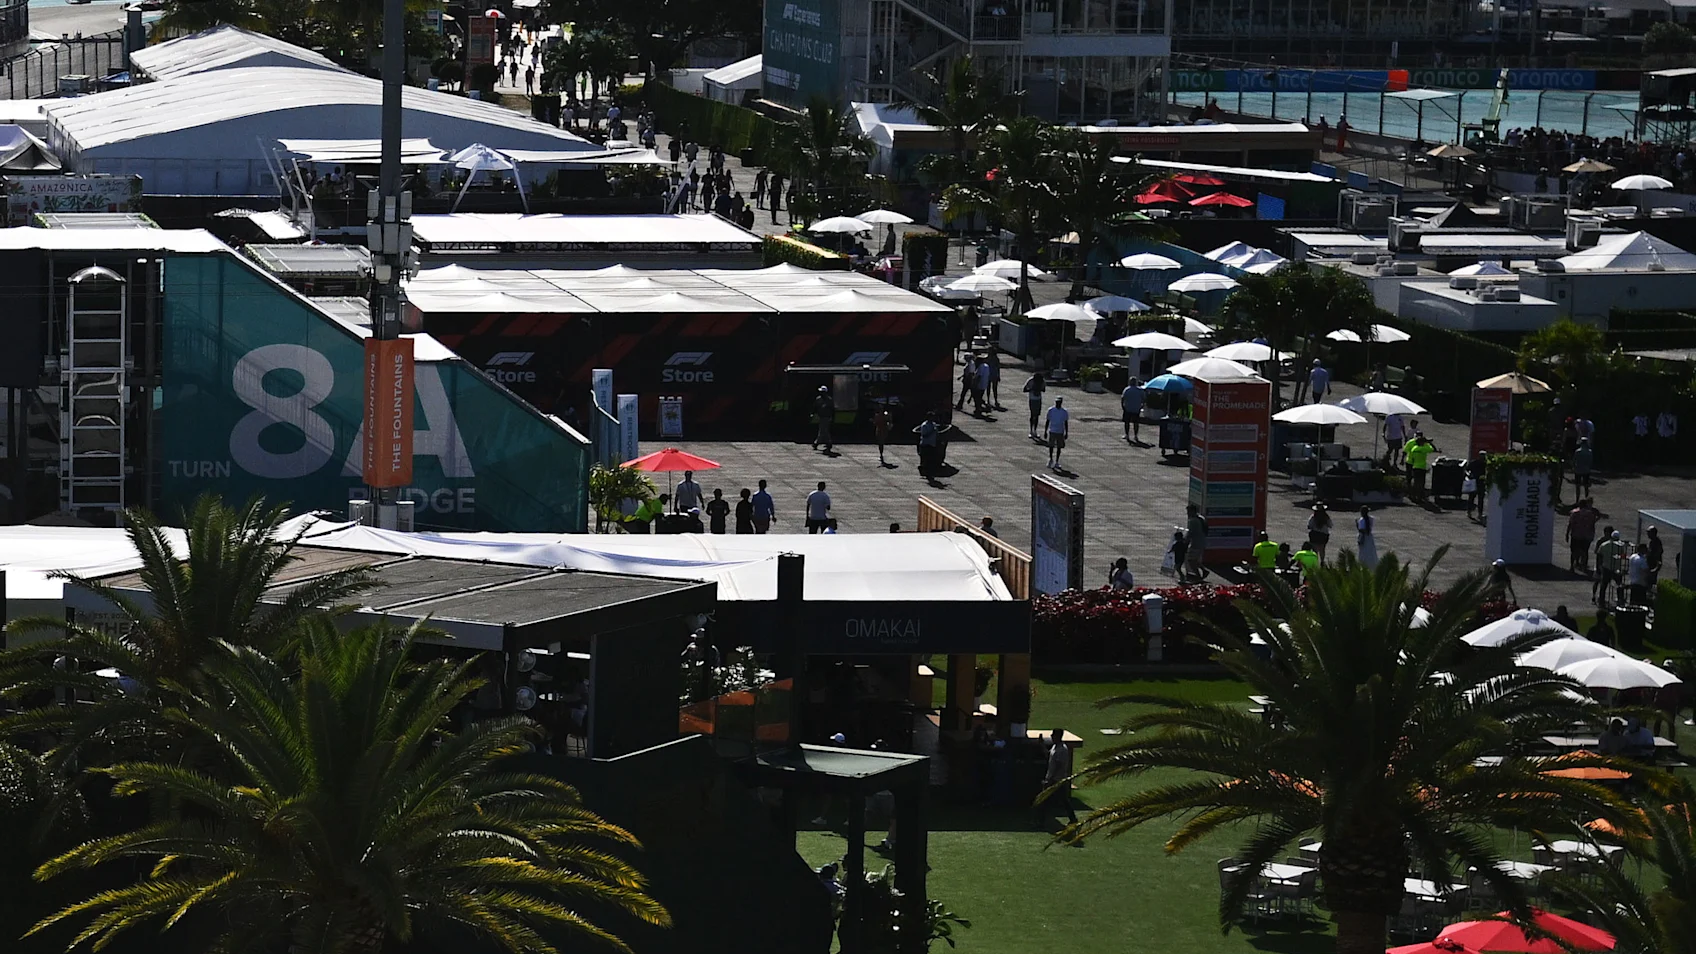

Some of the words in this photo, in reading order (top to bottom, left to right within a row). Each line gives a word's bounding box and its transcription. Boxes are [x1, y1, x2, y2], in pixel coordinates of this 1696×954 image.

[30, 183, 93, 193] AMAZONICA
[484, 368, 537, 383] Store
[661, 368, 714, 383] Store
[368, 353, 376, 438] FOUNTAINS
[392, 353, 403, 440] FOUNTAINS
[1212, 401, 1267, 409] PROMENADE
[392, 443, 402, 472] THE
[168, 459, 232, 479] TURN
[348, 487, 476, 514] BDGE
[1516, 507, 1525, 519] THE
[1524, 479, 1541, 546] PROMENADE
[845, 618, 921, 638] OMAKAI
